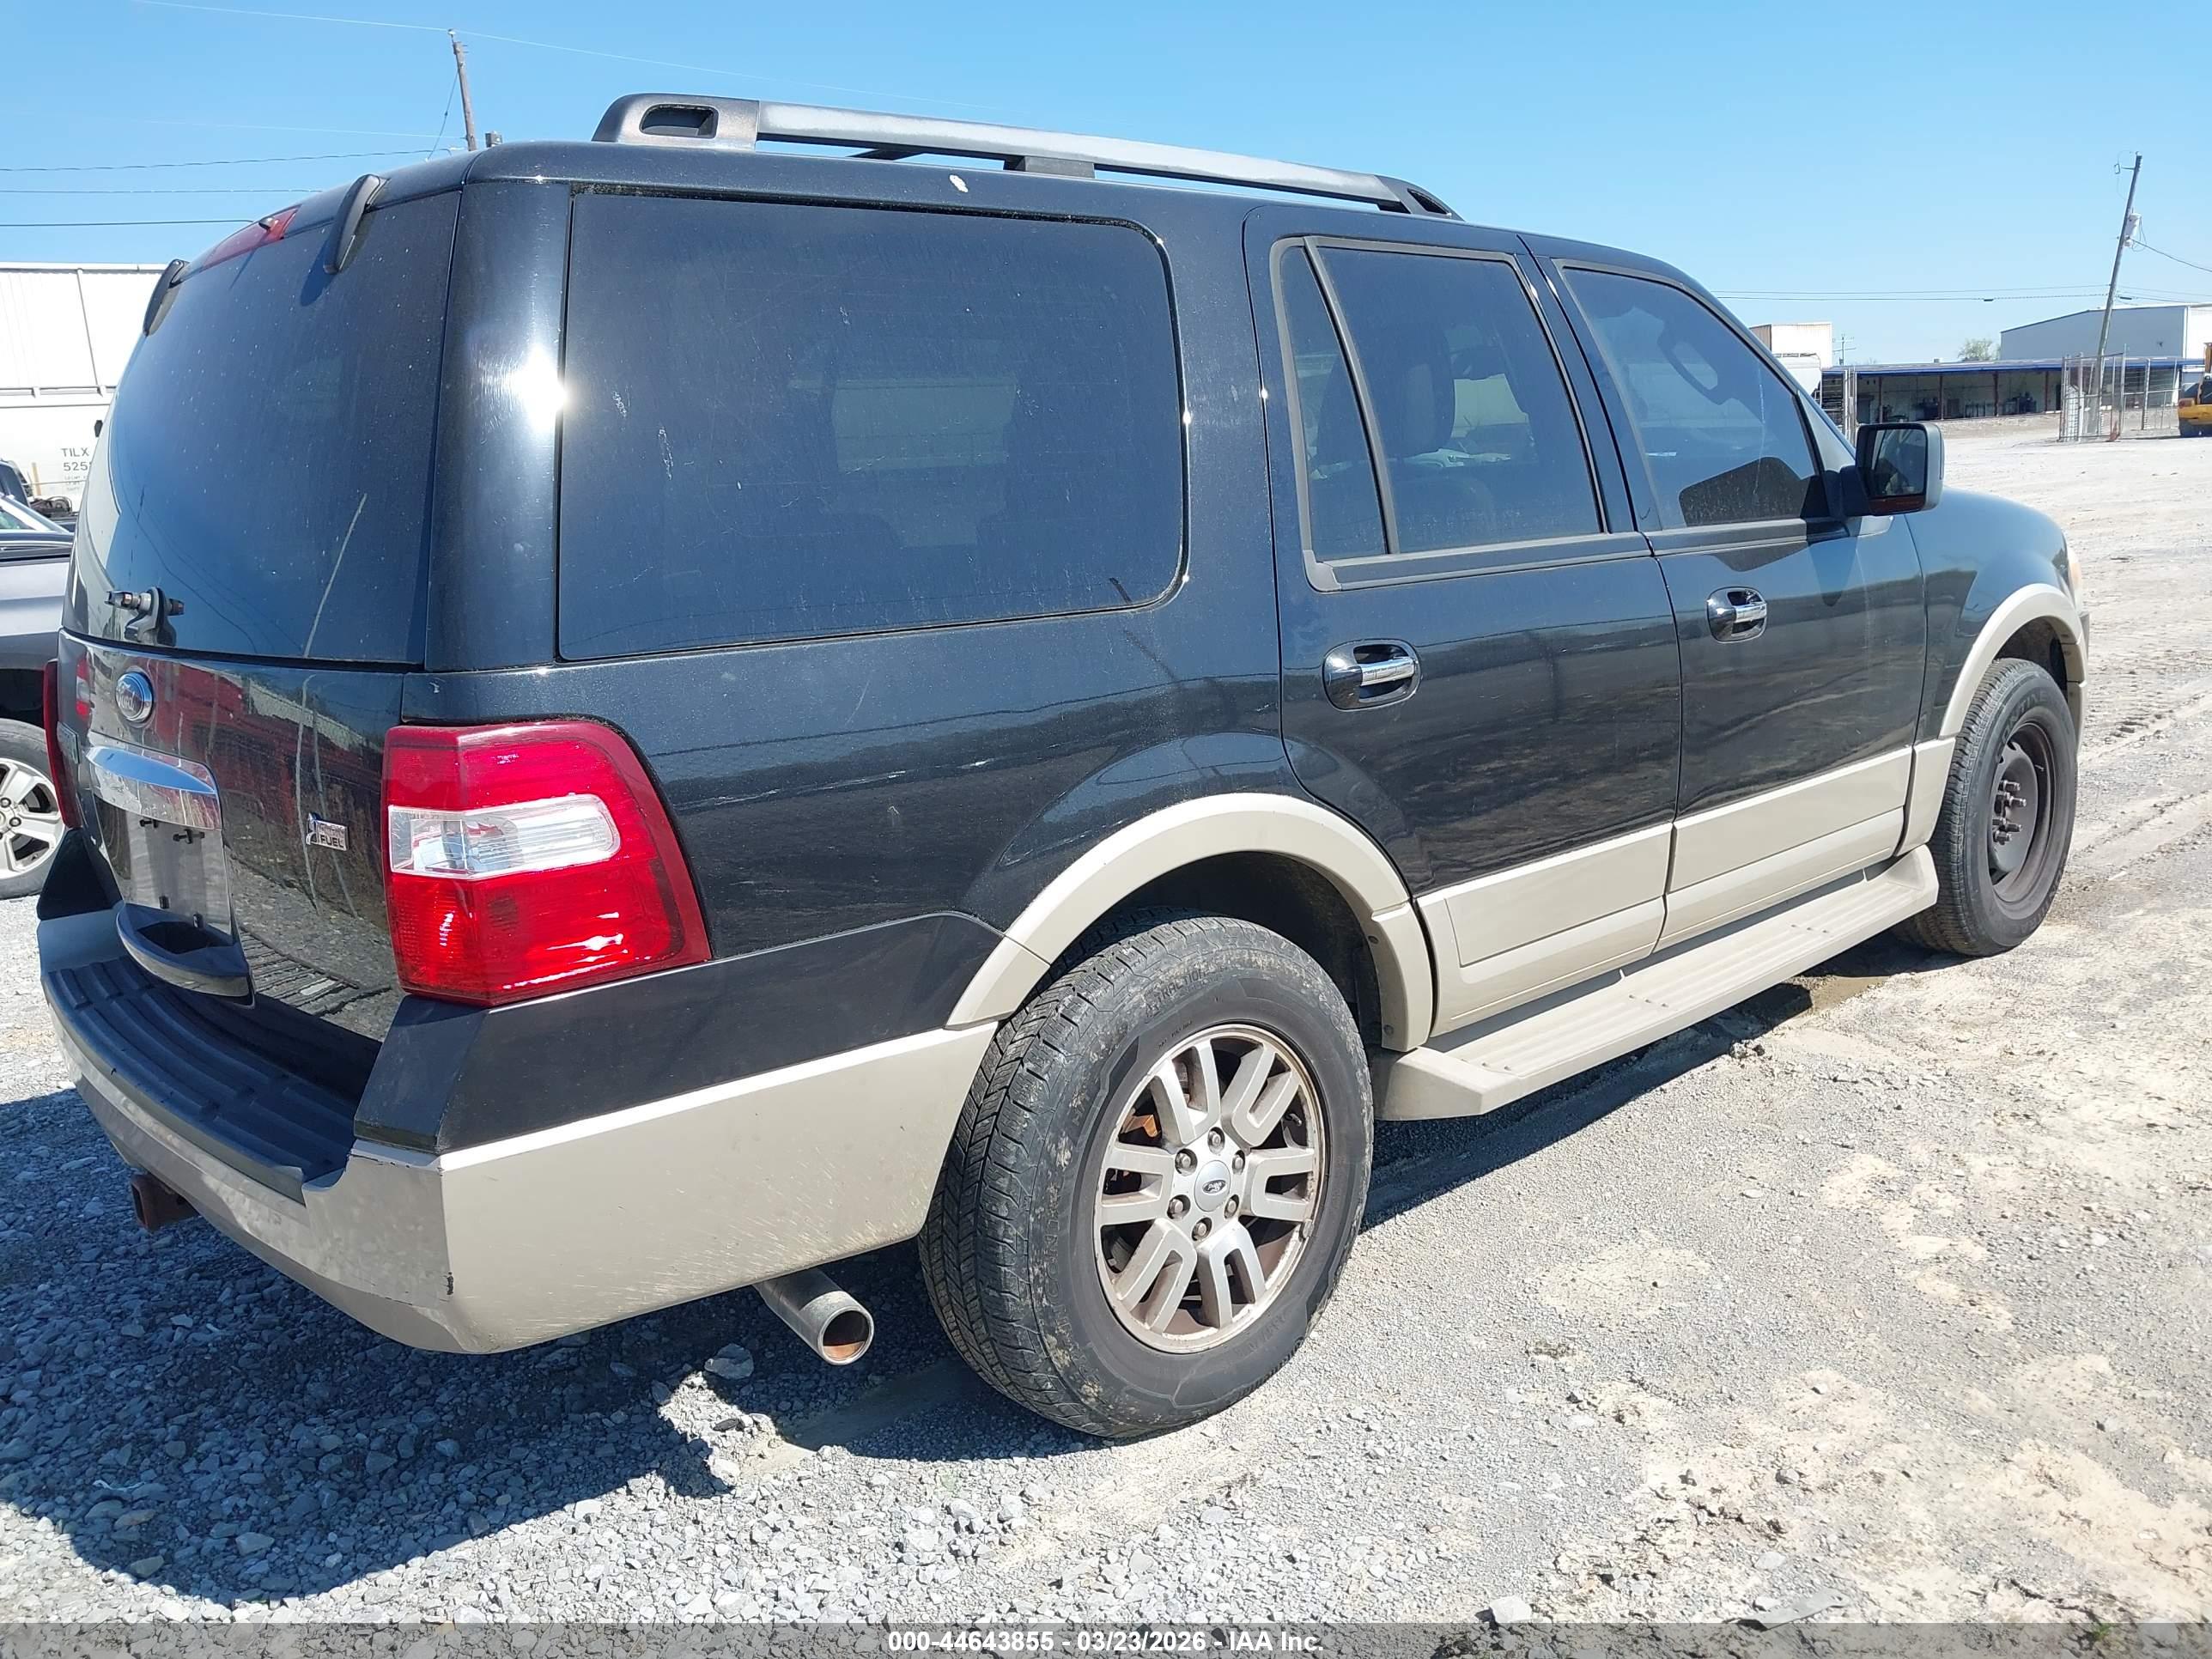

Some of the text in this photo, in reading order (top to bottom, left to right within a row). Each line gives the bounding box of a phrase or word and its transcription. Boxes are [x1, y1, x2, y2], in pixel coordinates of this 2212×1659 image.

[60, 447, 90, 457] TILX
[63, 461, 92, 471] 525
[320, 835, 344, 848] FUEL
